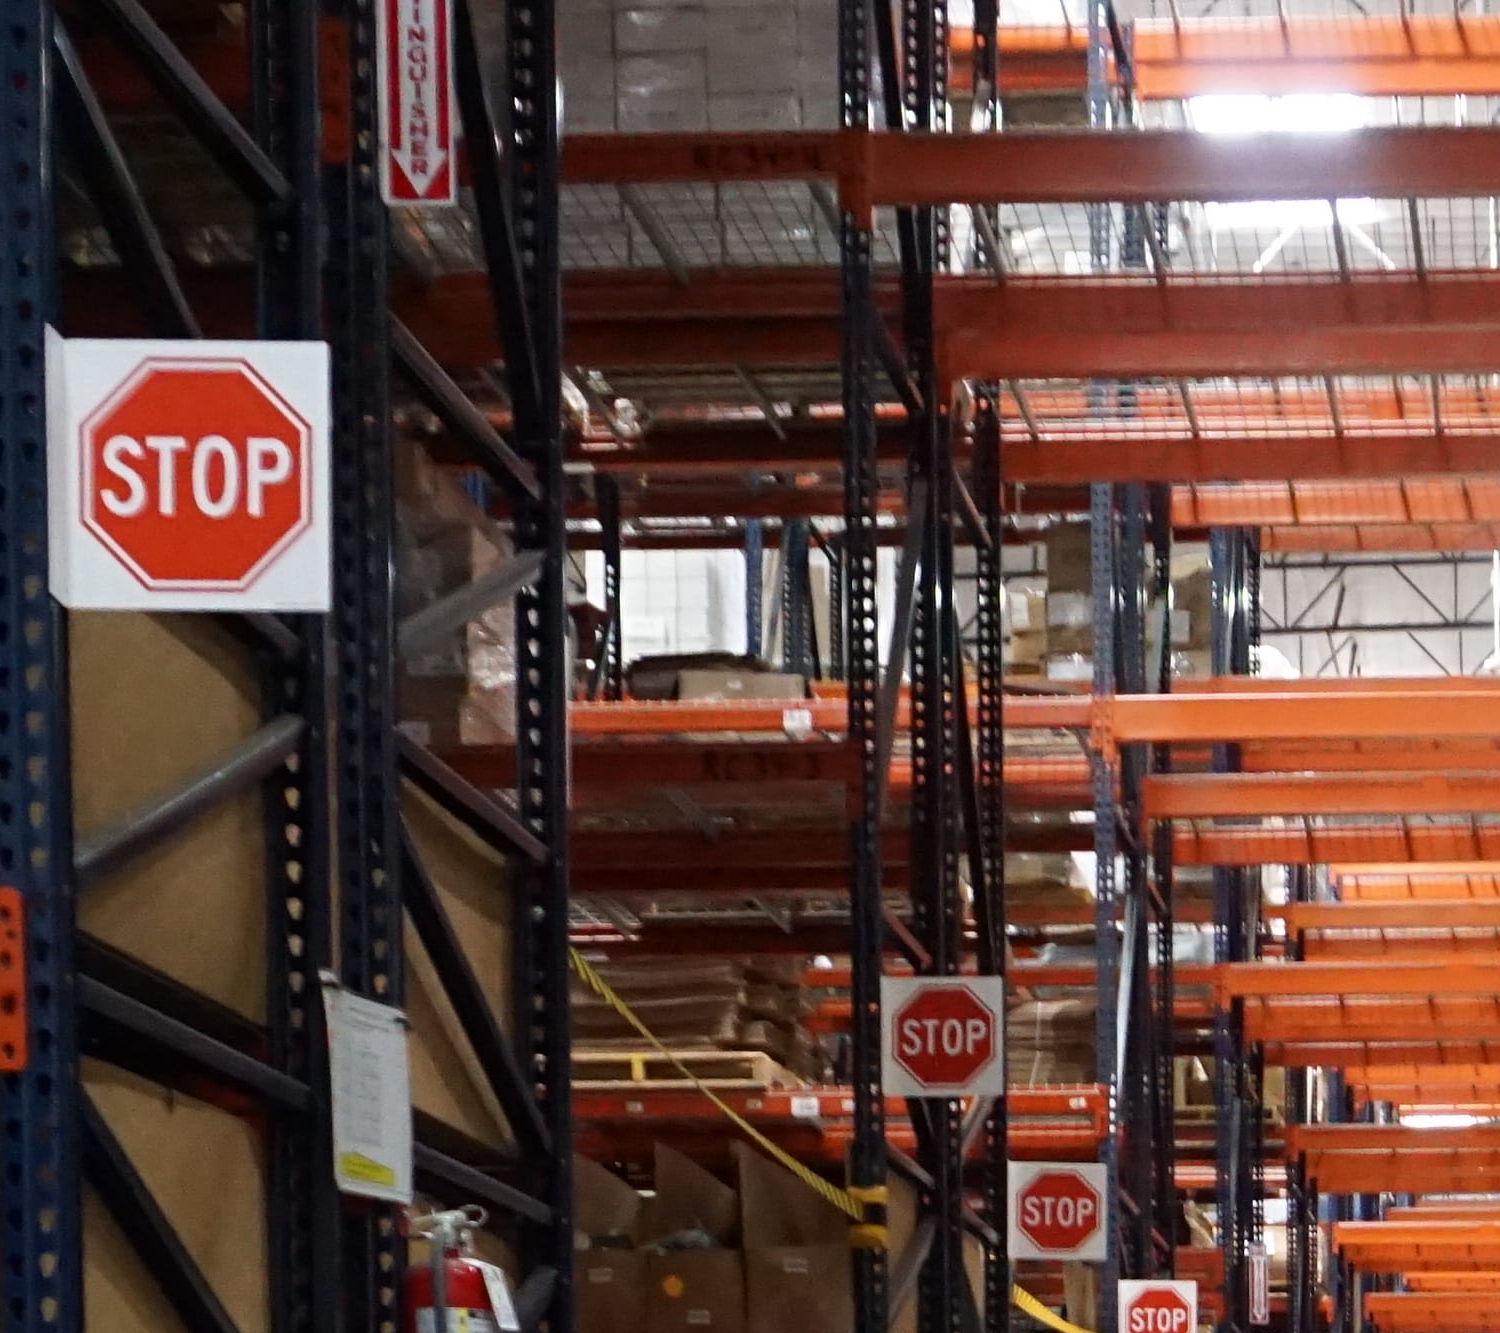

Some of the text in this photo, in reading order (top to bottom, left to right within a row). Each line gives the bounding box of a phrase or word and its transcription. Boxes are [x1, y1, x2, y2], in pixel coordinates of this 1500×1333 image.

[101, 434, 293, 518] STOP
[902, 1019, 986, 1055] STOP
[1024, 1197, 1095, 1226] STOP
[1131, 1308, 1186, 1333] STOP
